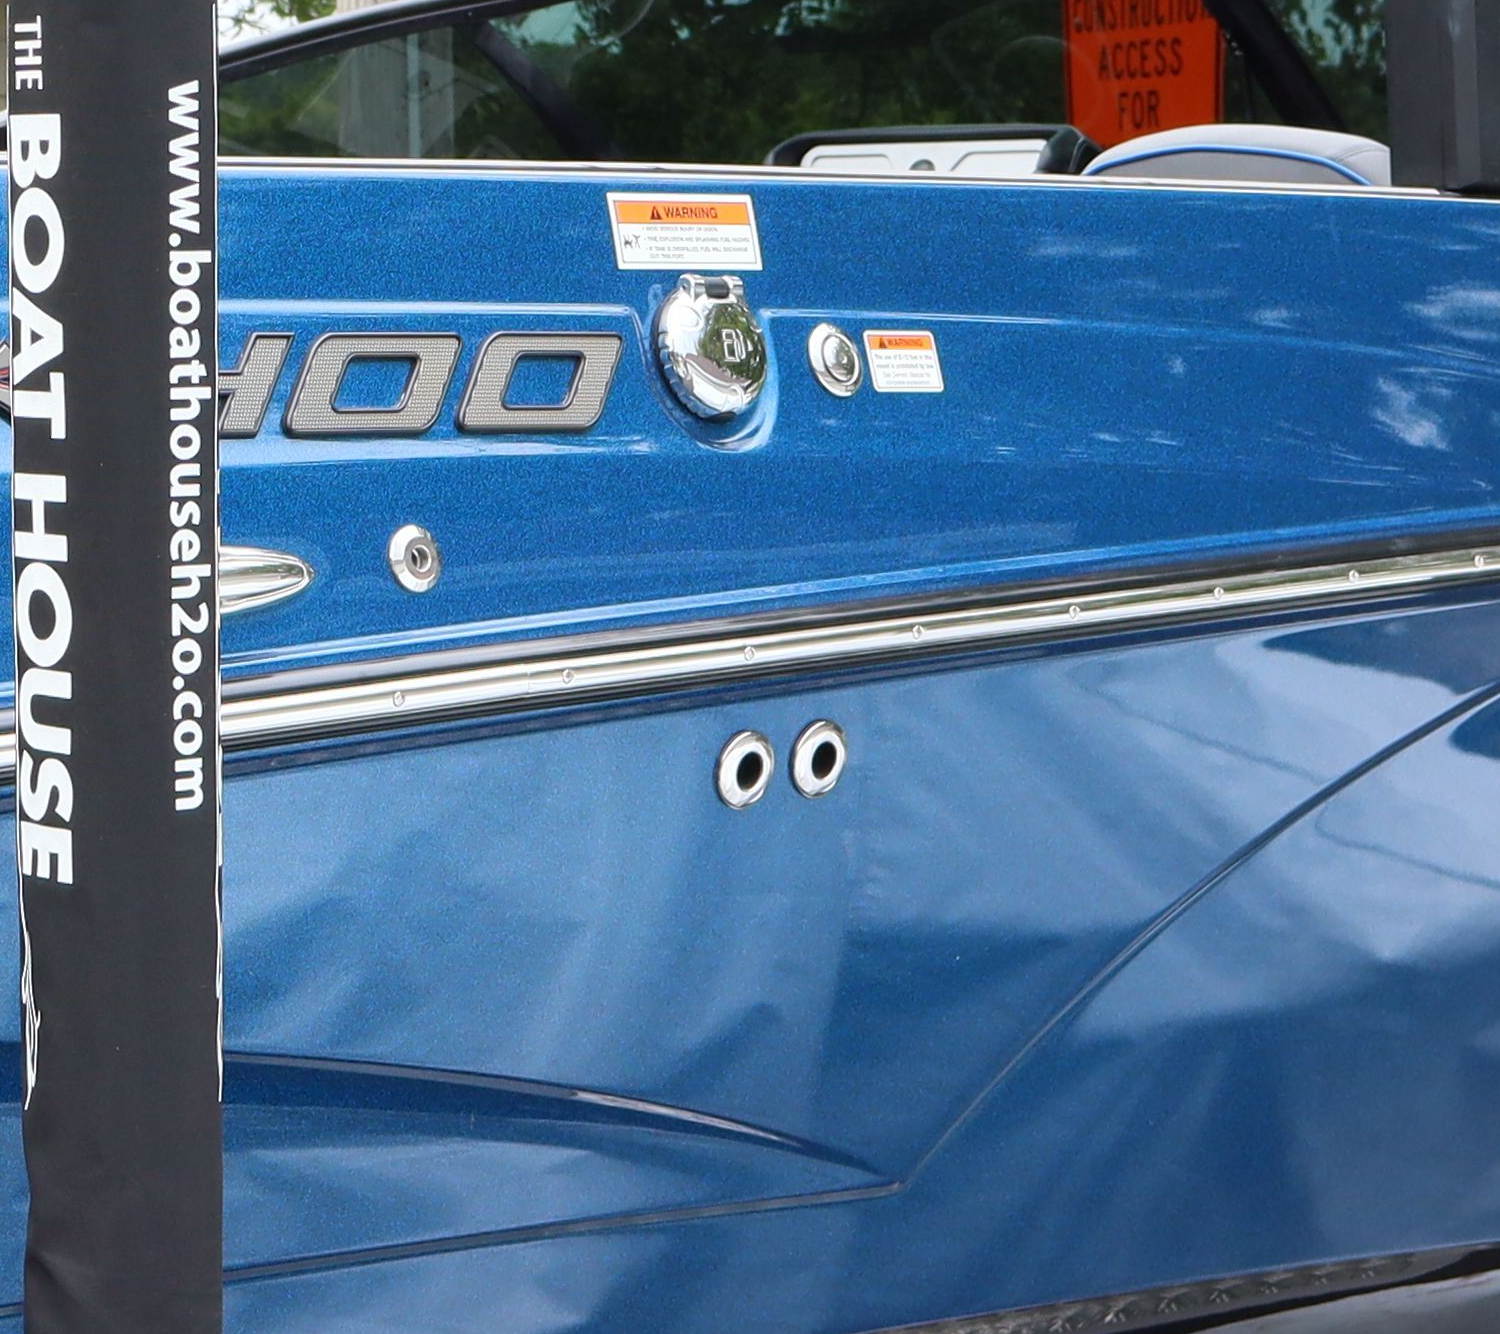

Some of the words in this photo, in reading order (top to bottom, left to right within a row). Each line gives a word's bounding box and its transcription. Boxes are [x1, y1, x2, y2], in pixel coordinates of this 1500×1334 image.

[13, 14, 43, 91] THE
[1098, 36, 1184, 80] ACCESS
[1117, 89, 1161, 130] FOR
[663, 205, 718, 219] WARNING
[9, 113, 67, 441] BOAT
[167, 78, 213, 813] www.boathouseh2o.com
[13, 472, 74, 886] HOUSE
